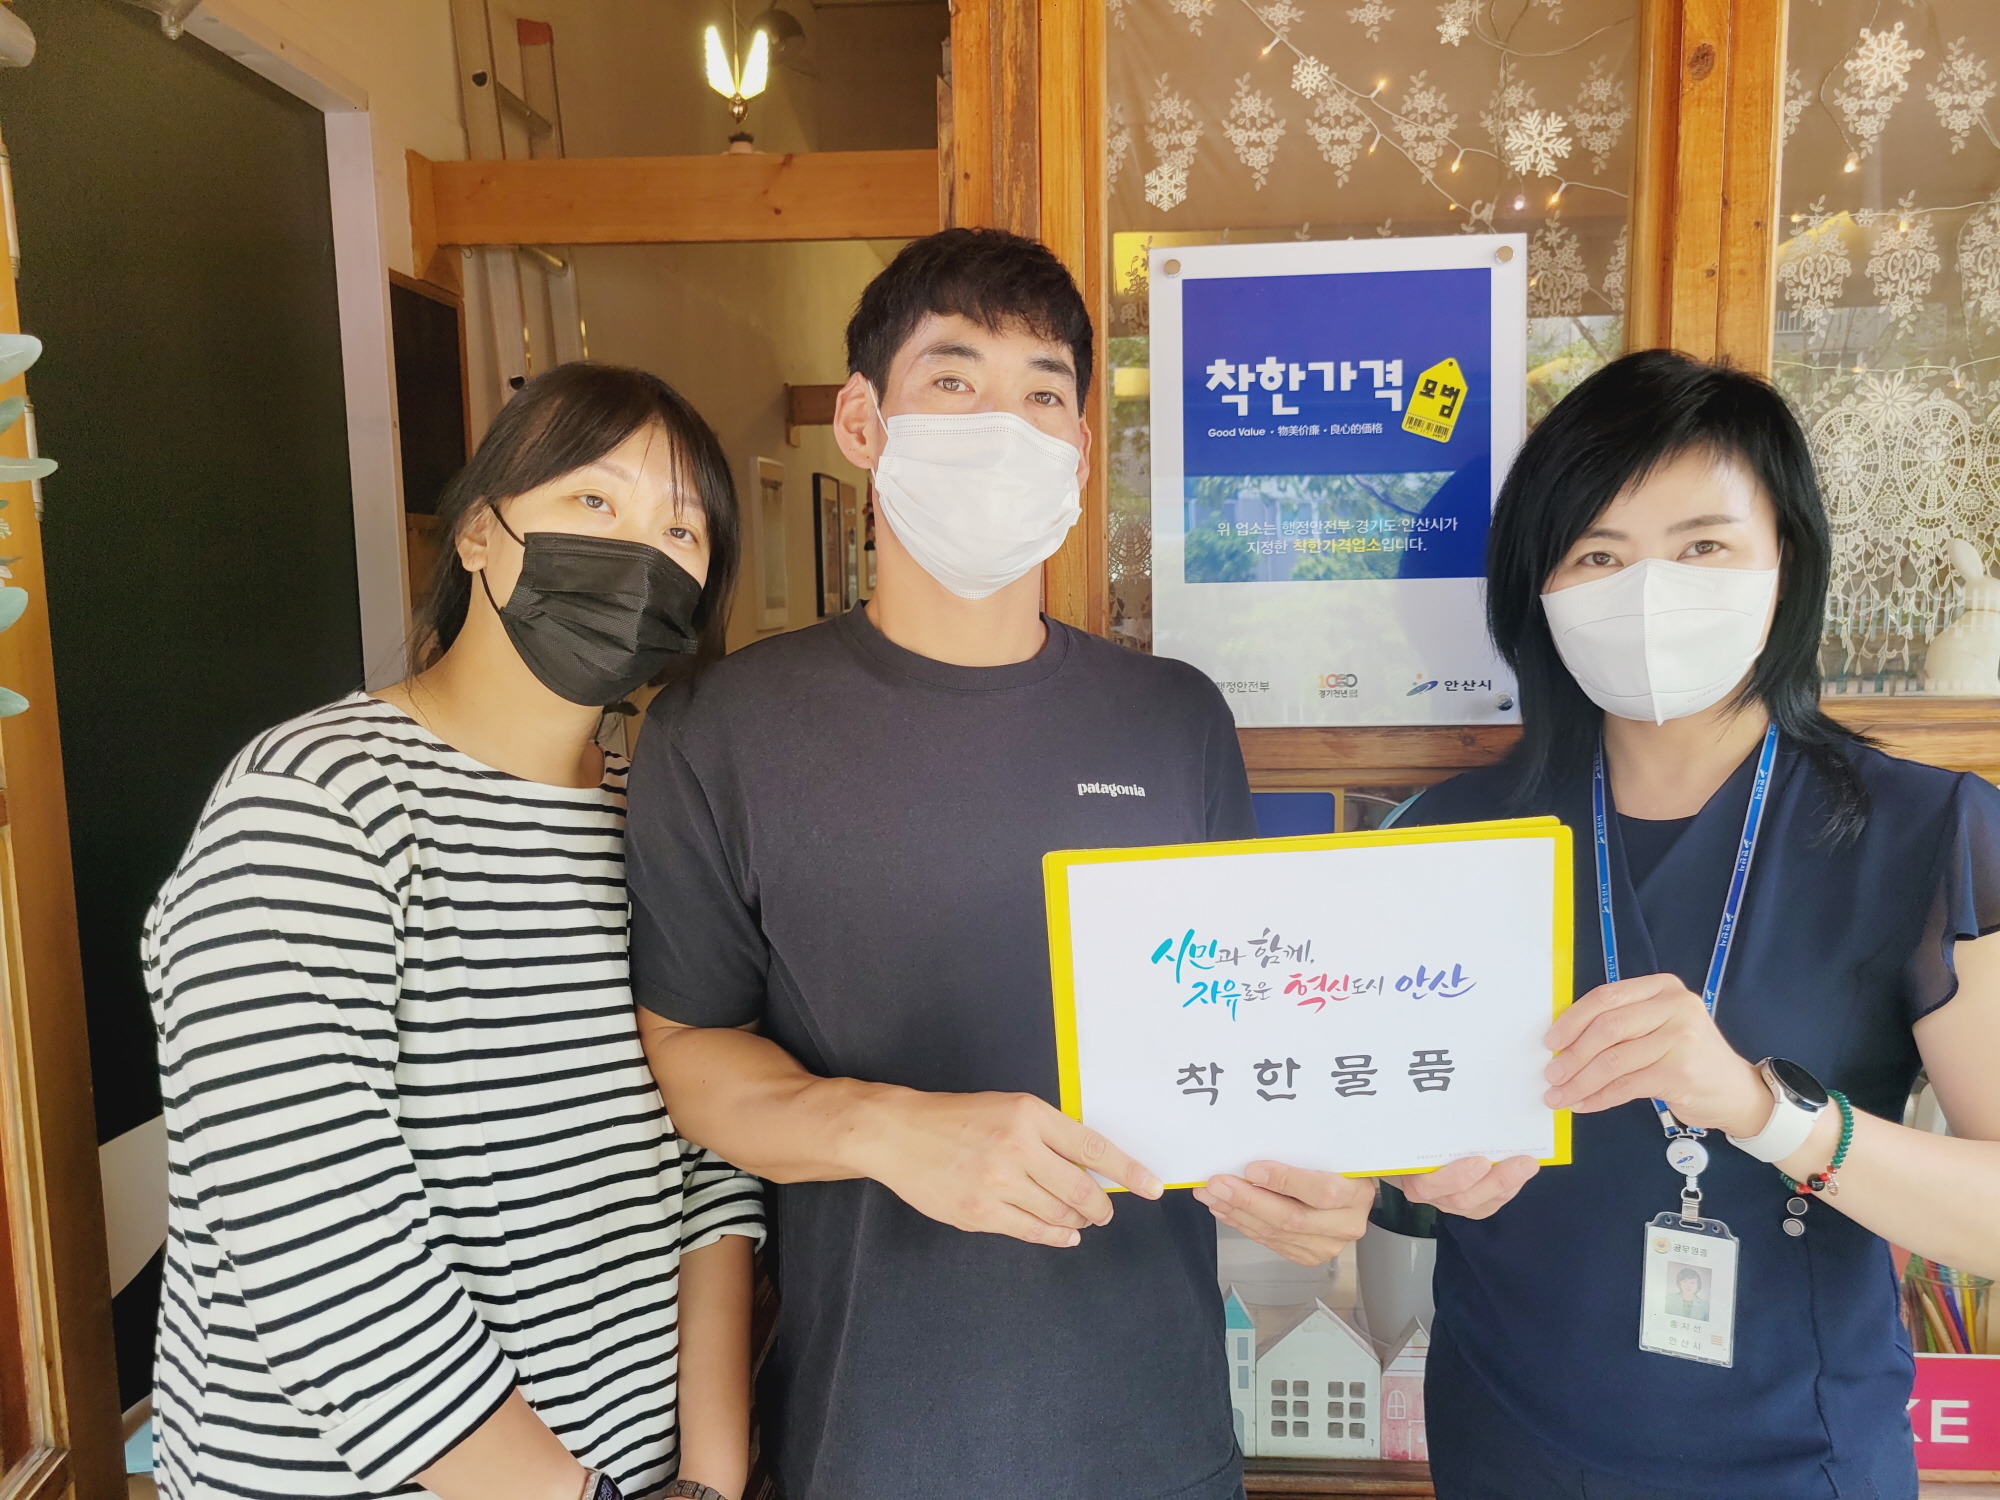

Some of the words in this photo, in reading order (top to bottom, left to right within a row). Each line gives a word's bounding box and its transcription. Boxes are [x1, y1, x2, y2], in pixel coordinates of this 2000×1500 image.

[1206, 356, 1402, 417] 착한가격
[1419, 379, 1460, 419] 모범
[1208, 428, 1236, 438] Good
[1238, 427, 1266, 437] Value
[1217, 522, 1230, 537] 위
[1235, 521, 1277, 537] 업소는
[1246, 539, 1288, 555] 지정한
[1293, 537, 1427, 555] 착한가격업소입니다.
[1444, 679, 1491, 692] 안산시
[1077, 782, 1146, 798] patagonia
[1151, 928, 1247, 984] 시민과
[1247, 927, 1315, 968] 함께,
[1182, 979, 1273, 1022] 자유로운
[1283, 973, 1385, 1014] 혁신도시
[1395, 963, 1478, 1000] 안산
